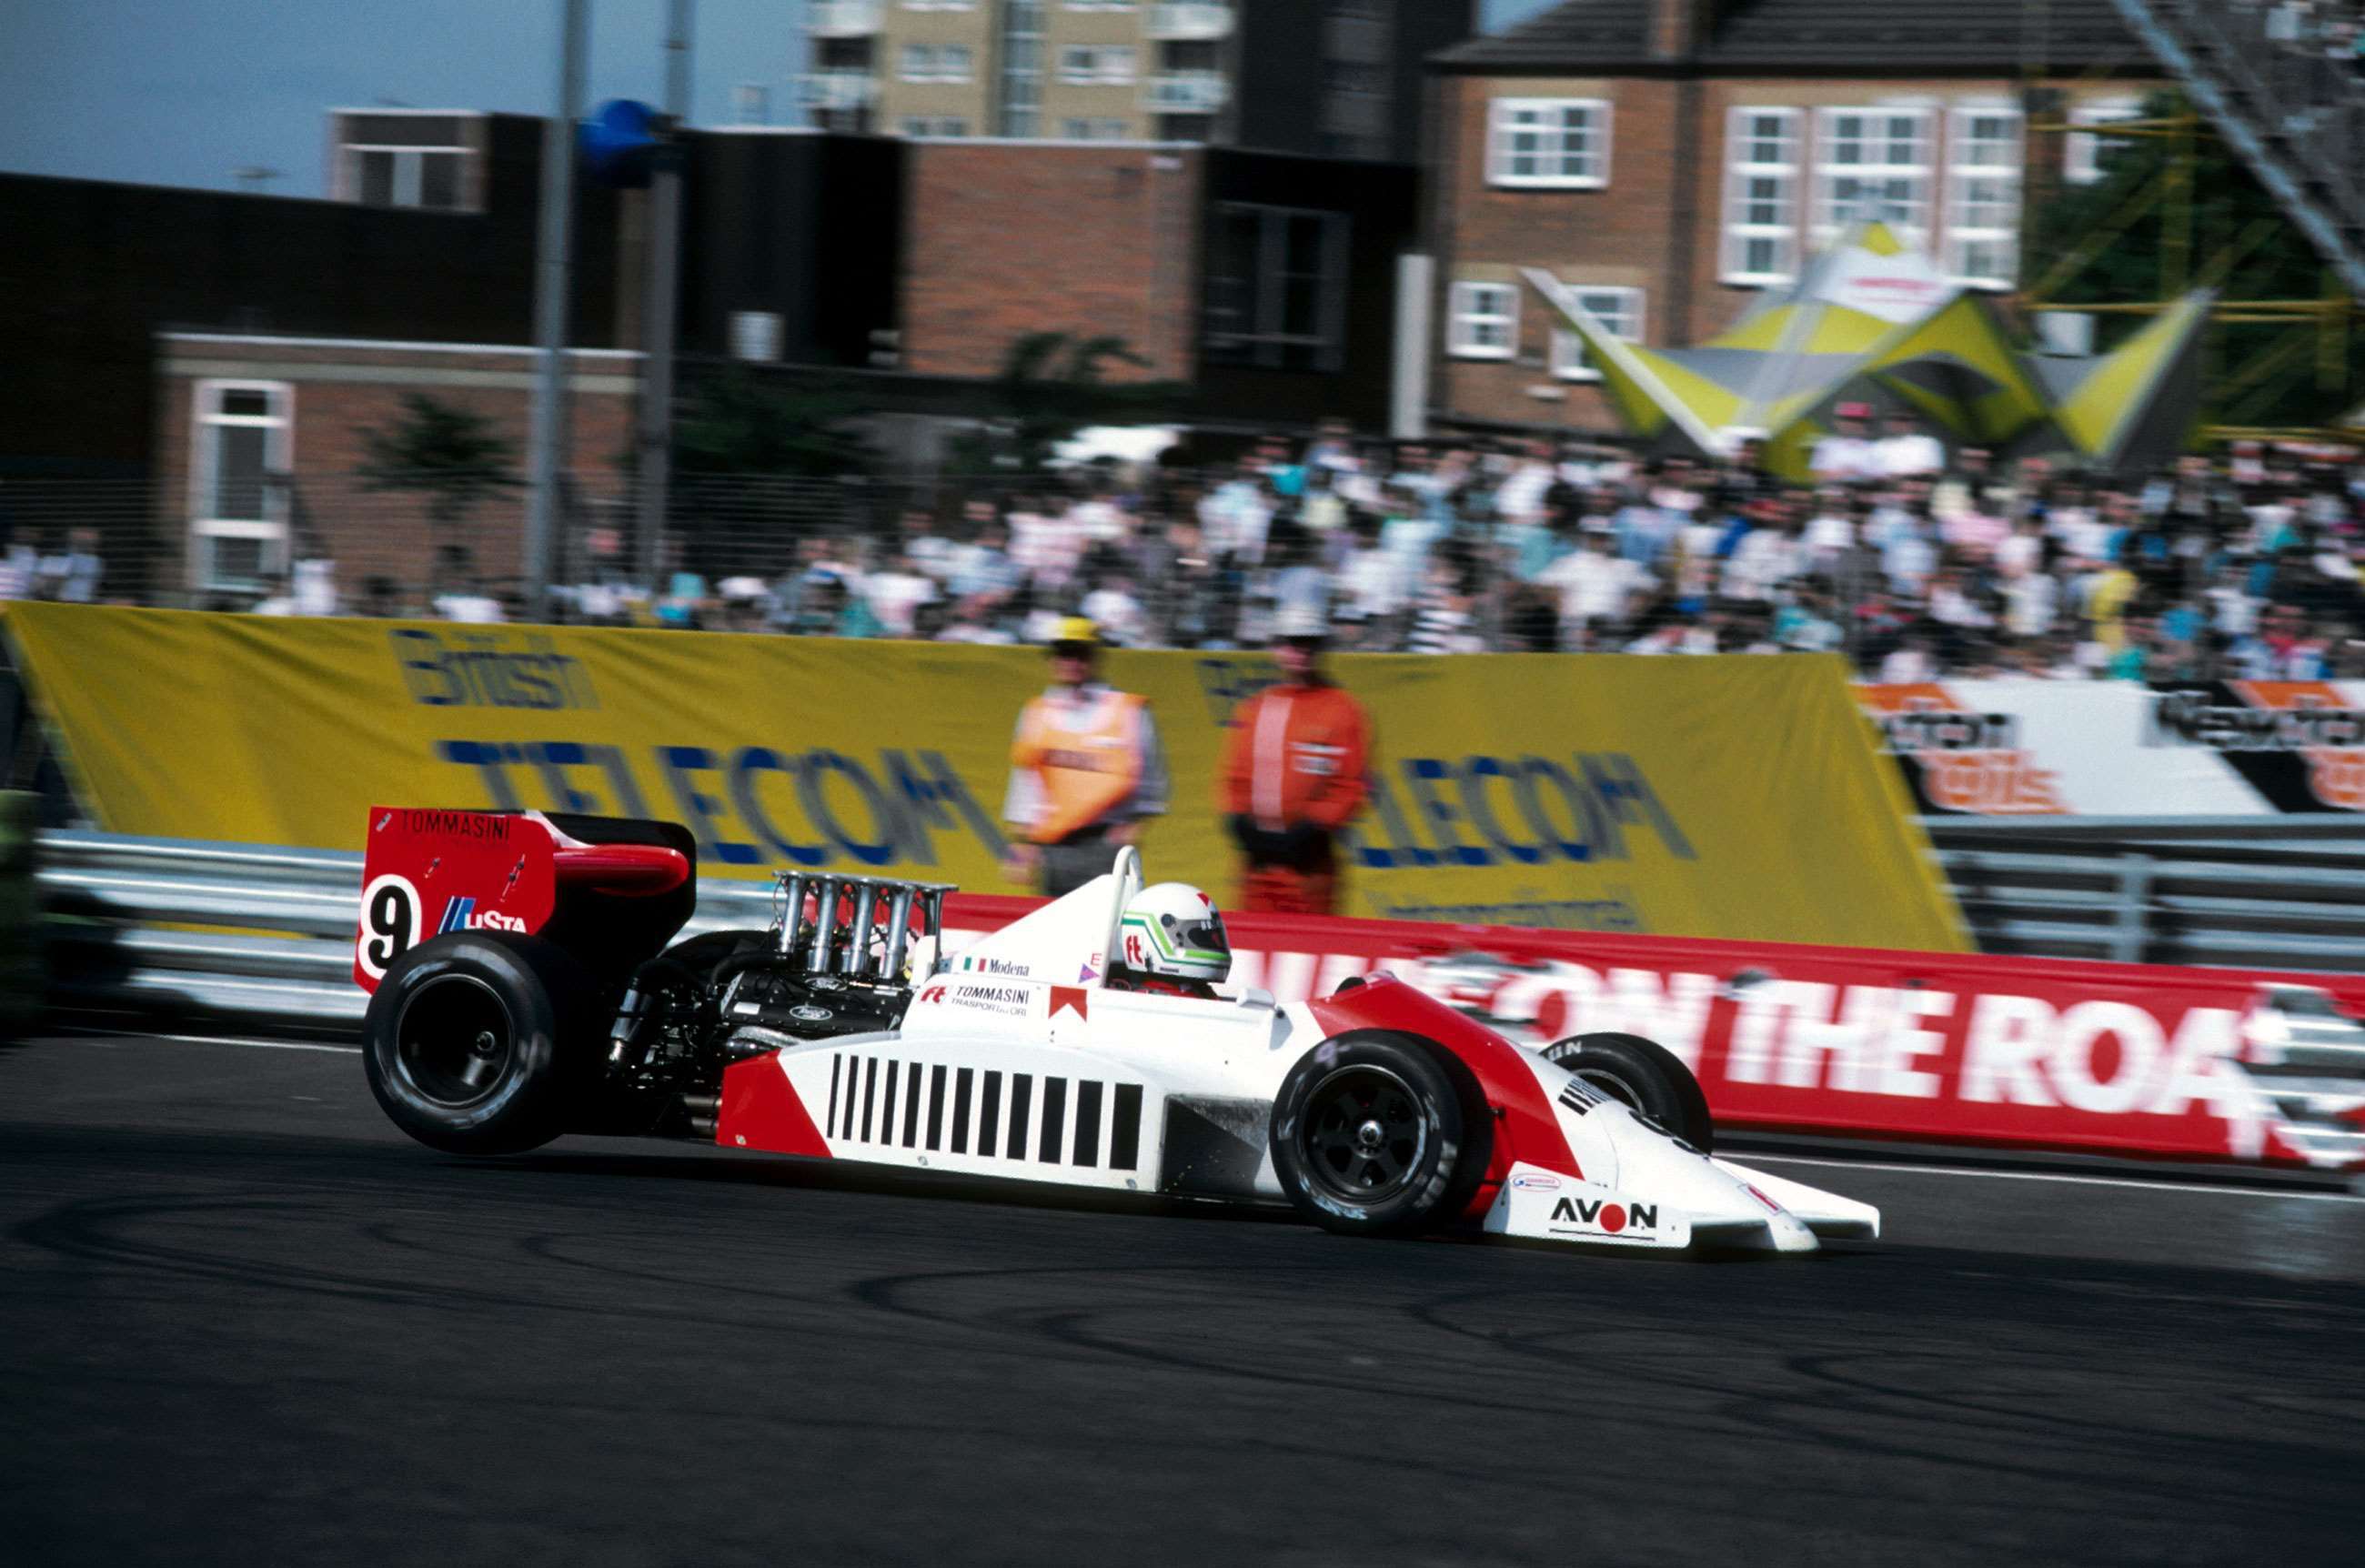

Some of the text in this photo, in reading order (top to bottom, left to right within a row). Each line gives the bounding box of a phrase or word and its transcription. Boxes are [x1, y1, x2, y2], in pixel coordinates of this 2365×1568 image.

[400, 809, 510, 840] TOMMASINI
[1353, 753, 1697, 868] LECOM
[367, 880, 417, 972] 9
[989, 958, 1031, 977] Modena
[957, 986, 1030, 1005] TOMMASINI
[1728, 979, 1957, 1101] THE
[1959, 993, 2288, 1119] ROA
[1550, 1197, 1657, 1233] AVON
